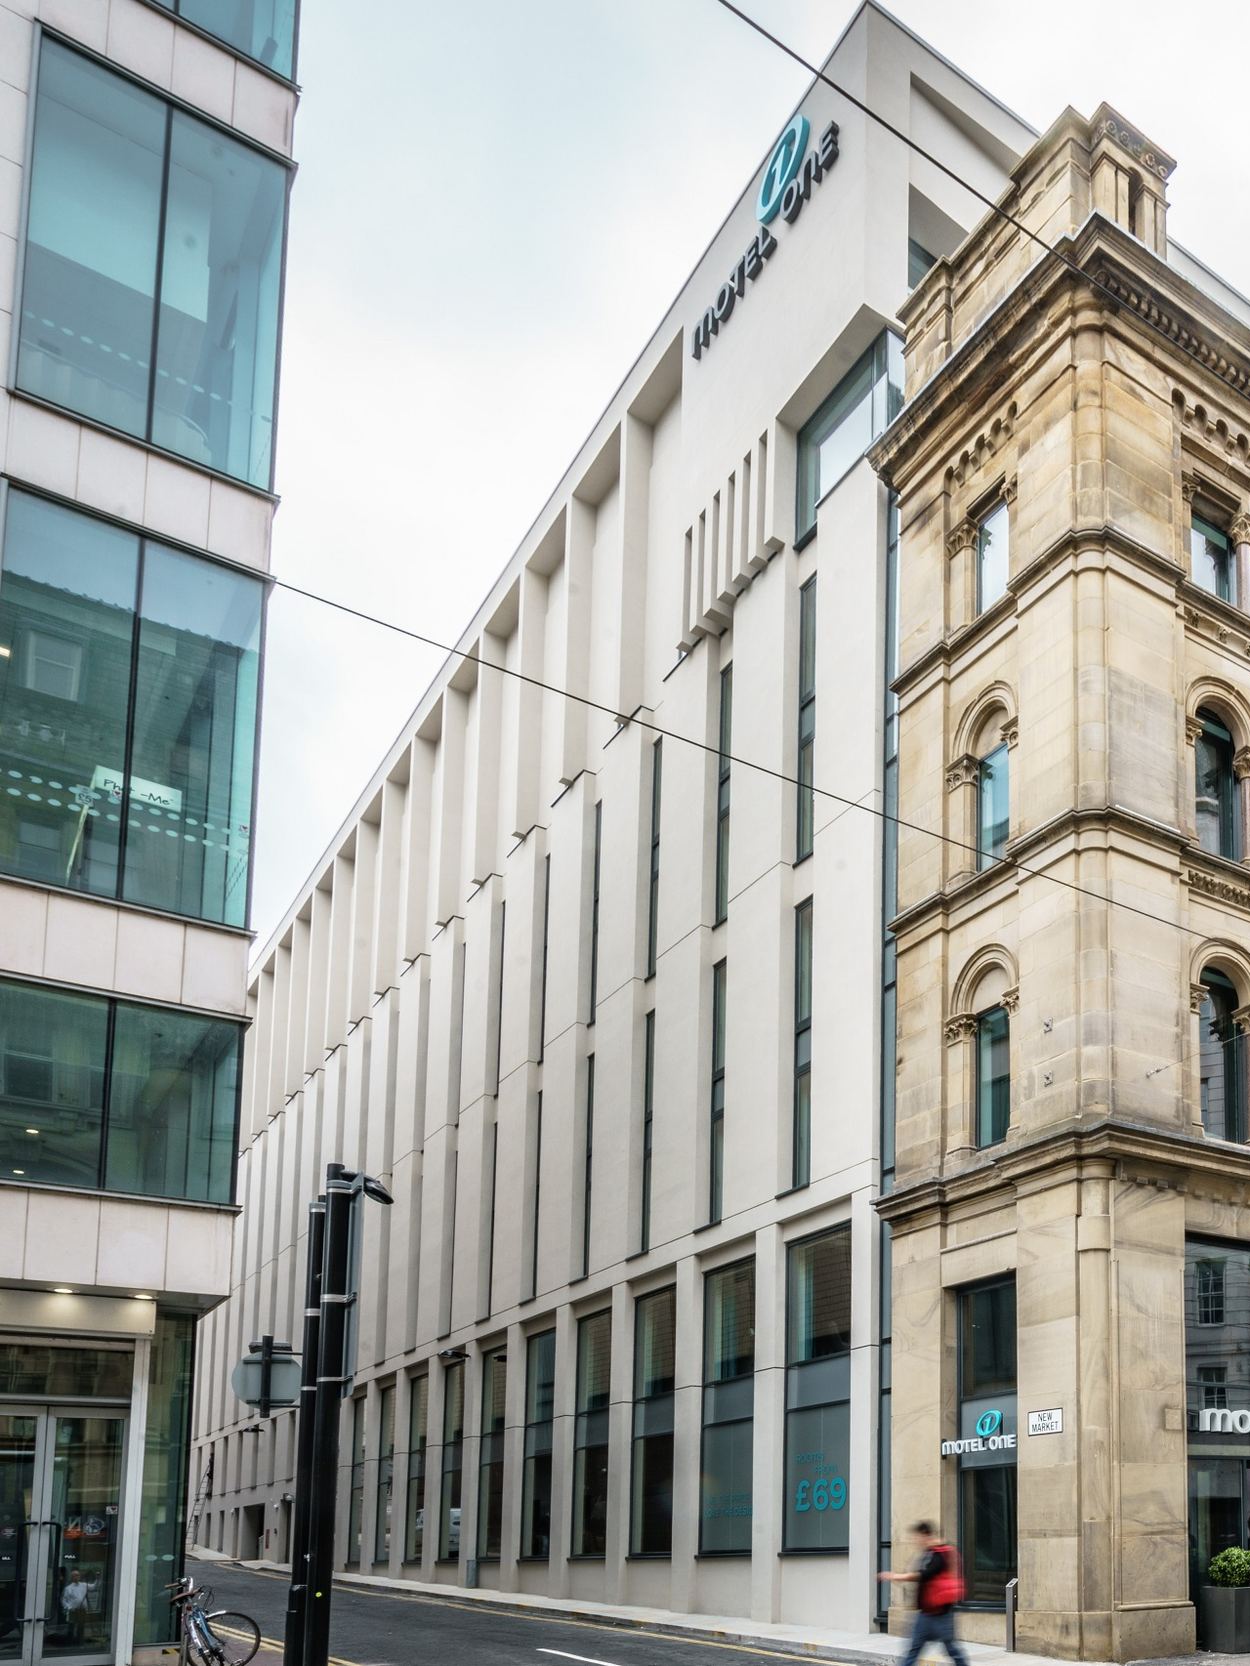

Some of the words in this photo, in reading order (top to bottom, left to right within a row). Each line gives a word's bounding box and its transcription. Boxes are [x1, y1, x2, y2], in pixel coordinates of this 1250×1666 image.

[692, 225, 778, 361] MOTEL
[780, 120, 839, 225] ONE
[1031, 1421, 1059, 1433] MARKET
[1037, 1412, 1053, 1422] NEW
[941, 1437, 987, 1456] MOTEL
[988, 1434, 1017, 1451] ONE
[795, 1476, 848, 1513] £69
